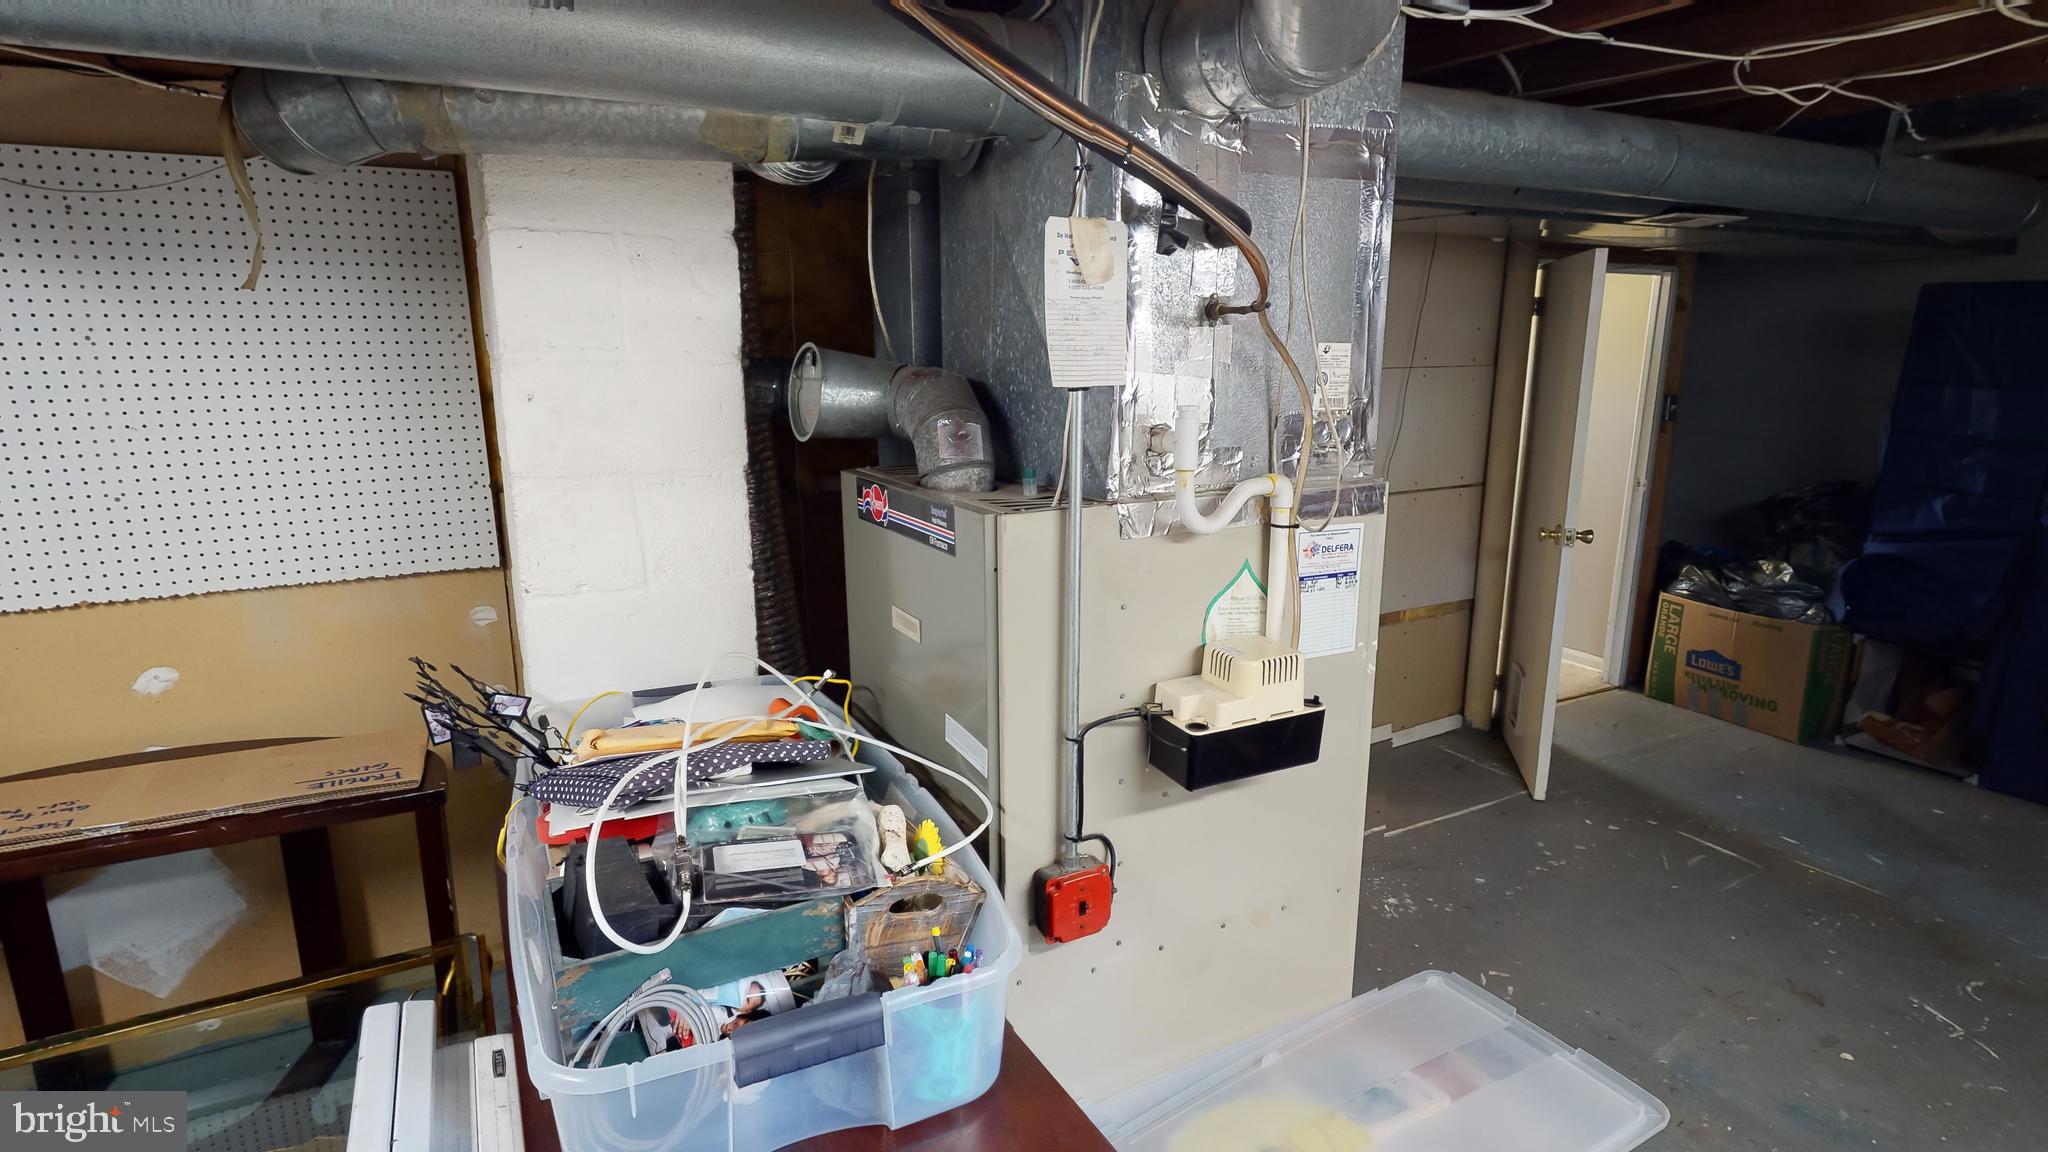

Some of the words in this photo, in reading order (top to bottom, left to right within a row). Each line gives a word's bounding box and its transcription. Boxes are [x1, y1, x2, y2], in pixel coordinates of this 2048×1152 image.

[1321, 543, 1354, 554] DELFERA
[1658, 602, 1668, 637] GRANDE
[1664, 604, 1681, 656] LARGE
[1691, 653, 1735, 676] LOWE'S
[306, 771, 401, 790] FRAGILE
